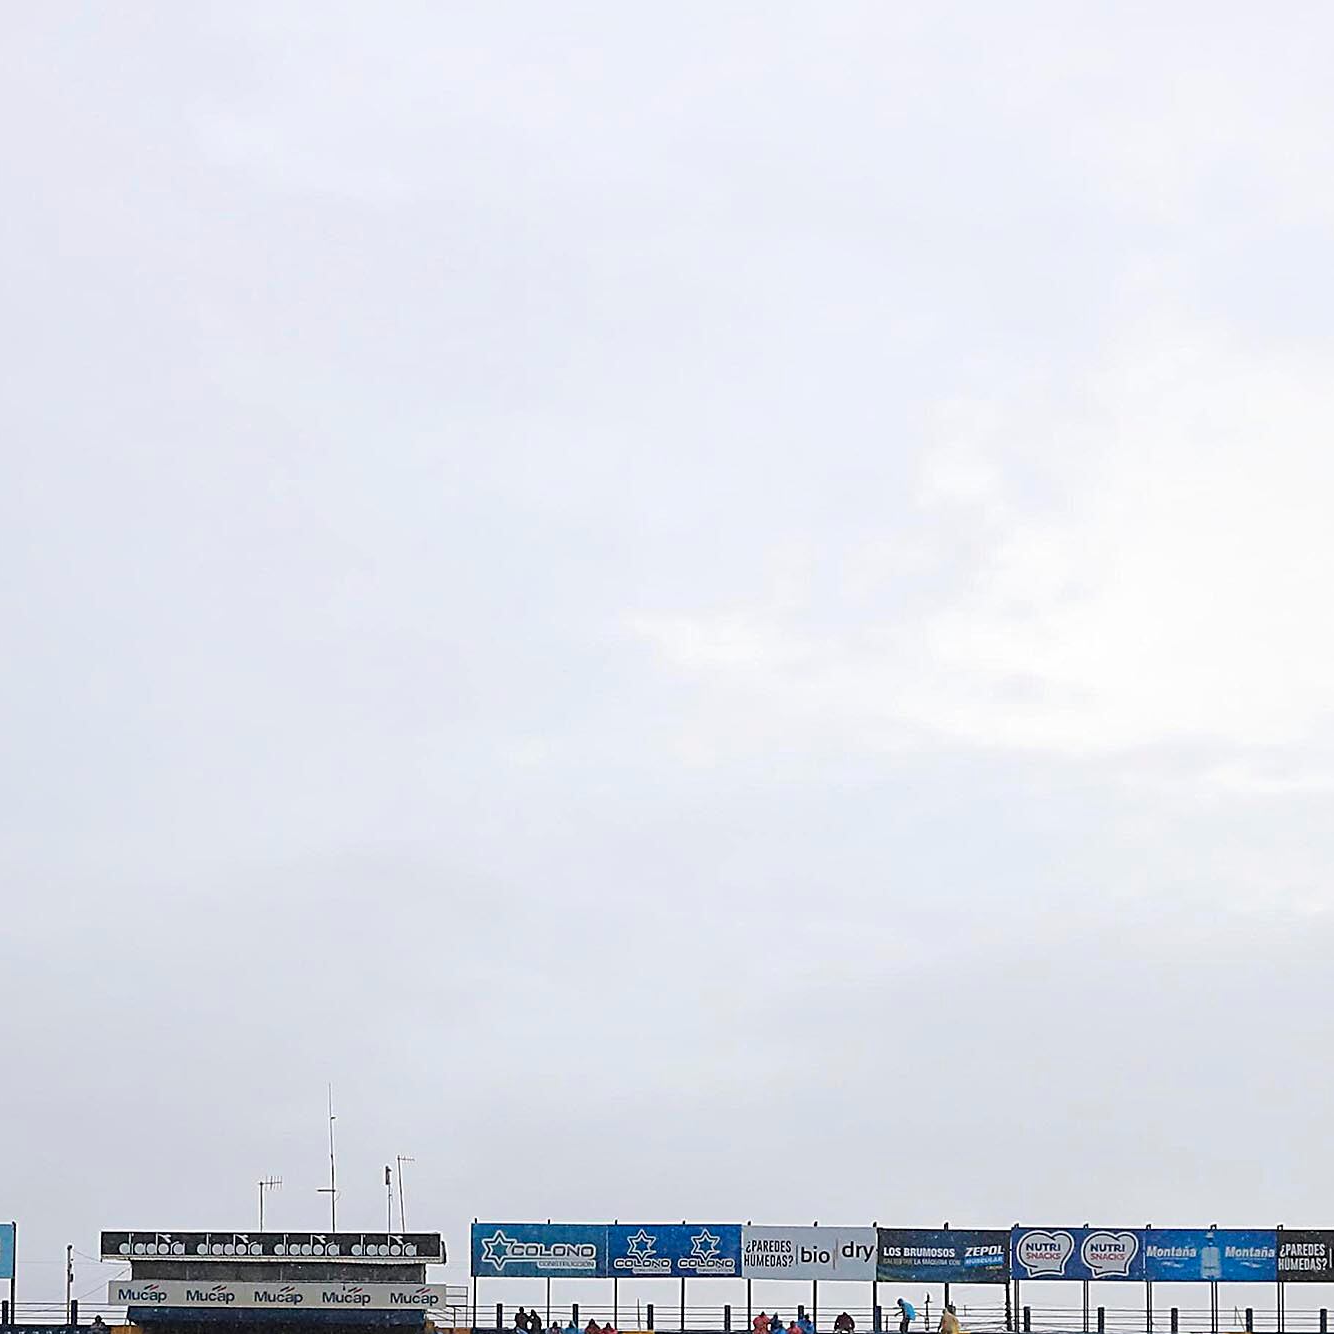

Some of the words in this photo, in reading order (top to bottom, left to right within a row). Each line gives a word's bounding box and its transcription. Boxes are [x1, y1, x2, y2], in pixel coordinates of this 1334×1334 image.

[119, 1233, 185, 1255] diadora
[197, 1233, 263, 1255] diadora
[274, 1234, 340, 1256] diadora
[352, 1234, 417, 1257] diadora
[745, 1240, 791, 1253] ¿PAREDES
[1025, 1242, 1061, 1252] NUTRI
[1090, 1243, 1125, 1252] NUTRI
[1279, 1243, 1325, 1257] ¿PAREDES
[511, 1245, 595, 1257] COLONO
[801, 1246, 830, 1264] bio
[841, 1242, 875, 1263] dry
[883, 1247, 901, 1257] LOS
[903, 1248, 955, 1258] BRUMOSOS
[965, 1245, 1004, 1257] ZEPOL
[1025, 1252, 1061, 1260] SNACKS
[1090, 1252, 1125, 1261] SNACKS
[615, 1259, 671, 1268] COLONO
[679, 1259, 735, 1268] COLONO
[118, 1289, 167, 1303] Mucap
[186, 1290, 235, 1304] Mucap
[254, 1291, 303, 1305] Mucap
[322, 1292, 371, 1306] Mucap
[390, 1293, 439, 1306] Mucap
